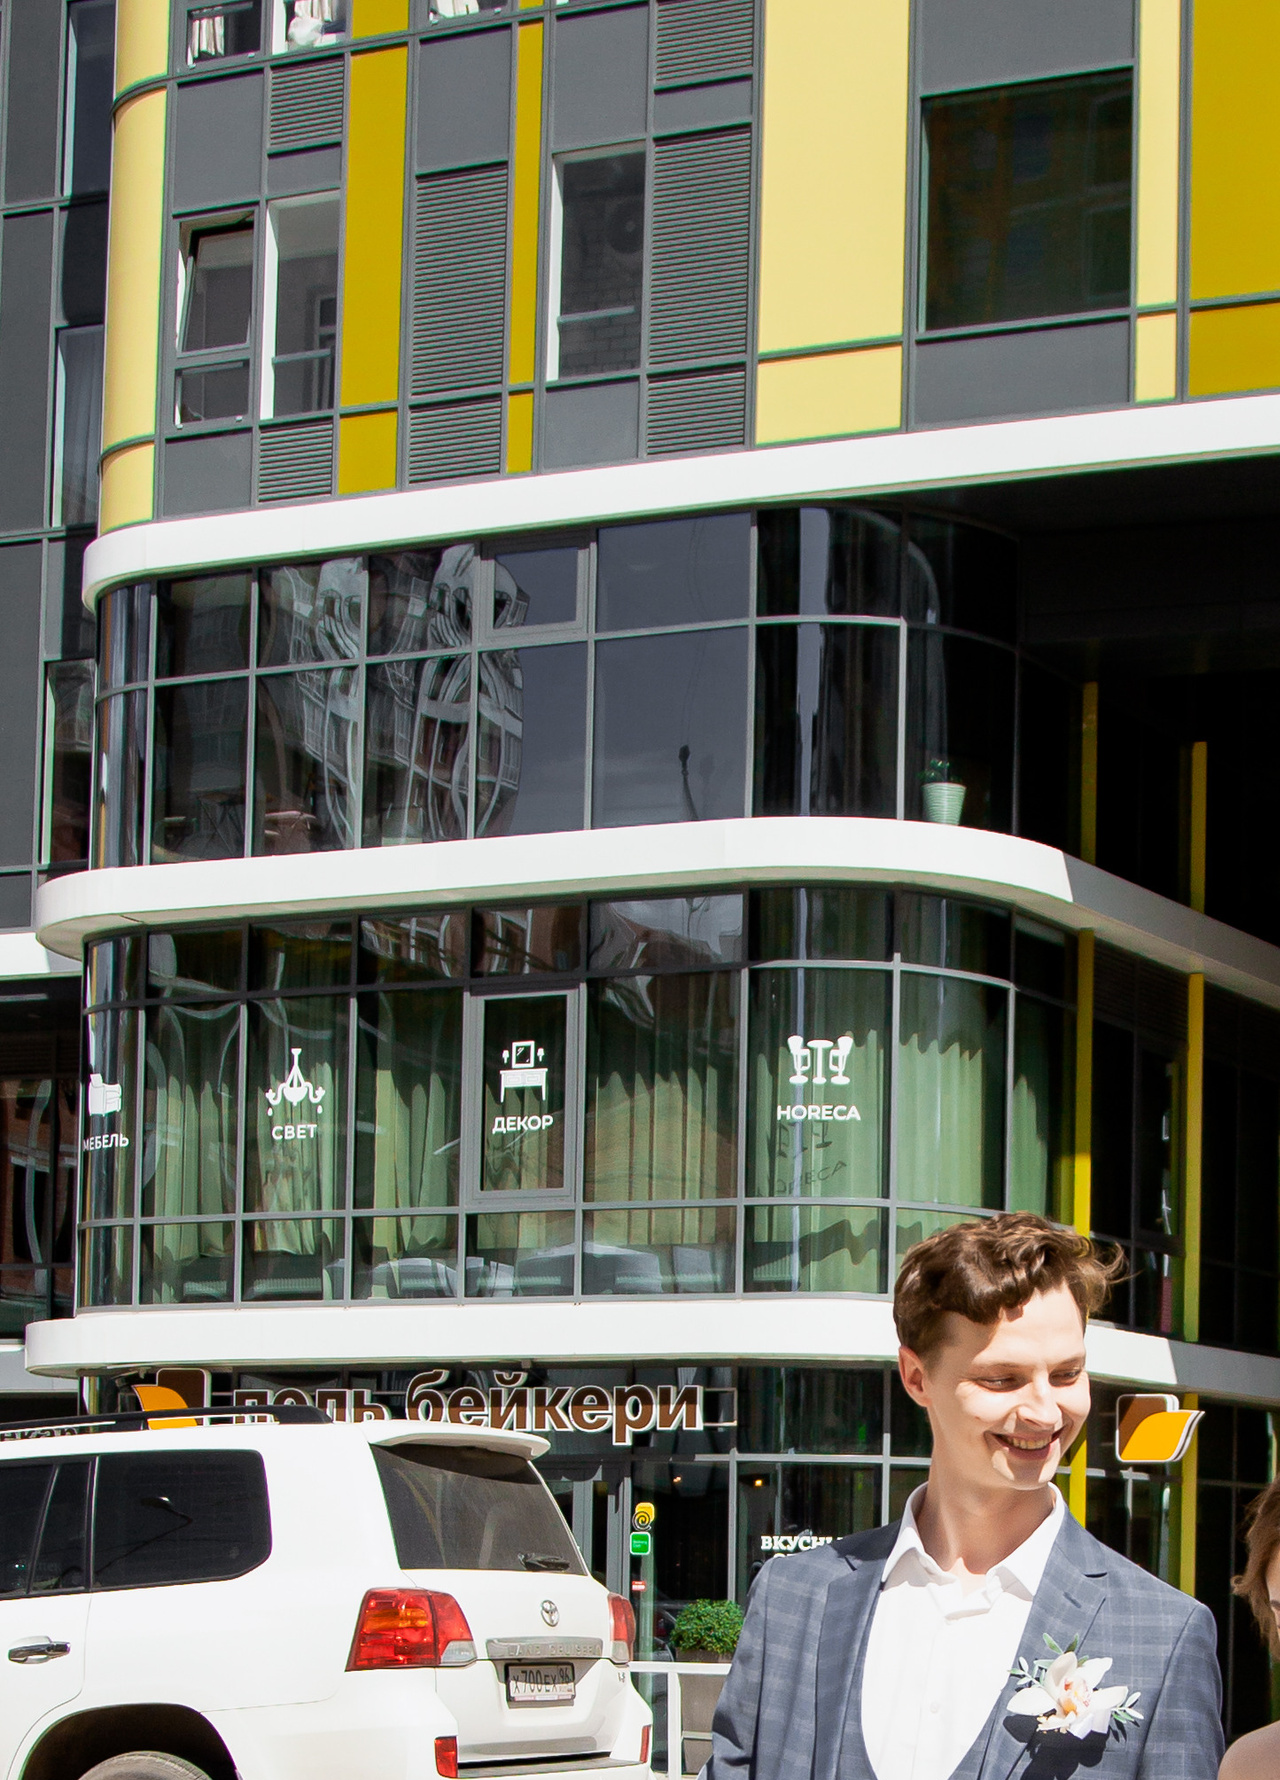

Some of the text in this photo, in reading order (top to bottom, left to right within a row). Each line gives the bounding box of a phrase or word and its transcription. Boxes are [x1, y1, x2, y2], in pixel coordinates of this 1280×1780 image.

[777, 1104, 861, 1121] HORECA
[271, 1124, 318, 1140] СВЕТ
[492, 1114, 554, 1135] ДЕКОР
[82, 1133, 129, 1152] МЕБЕЛЬ
[405, 1369, 704, 1446] бейкери
